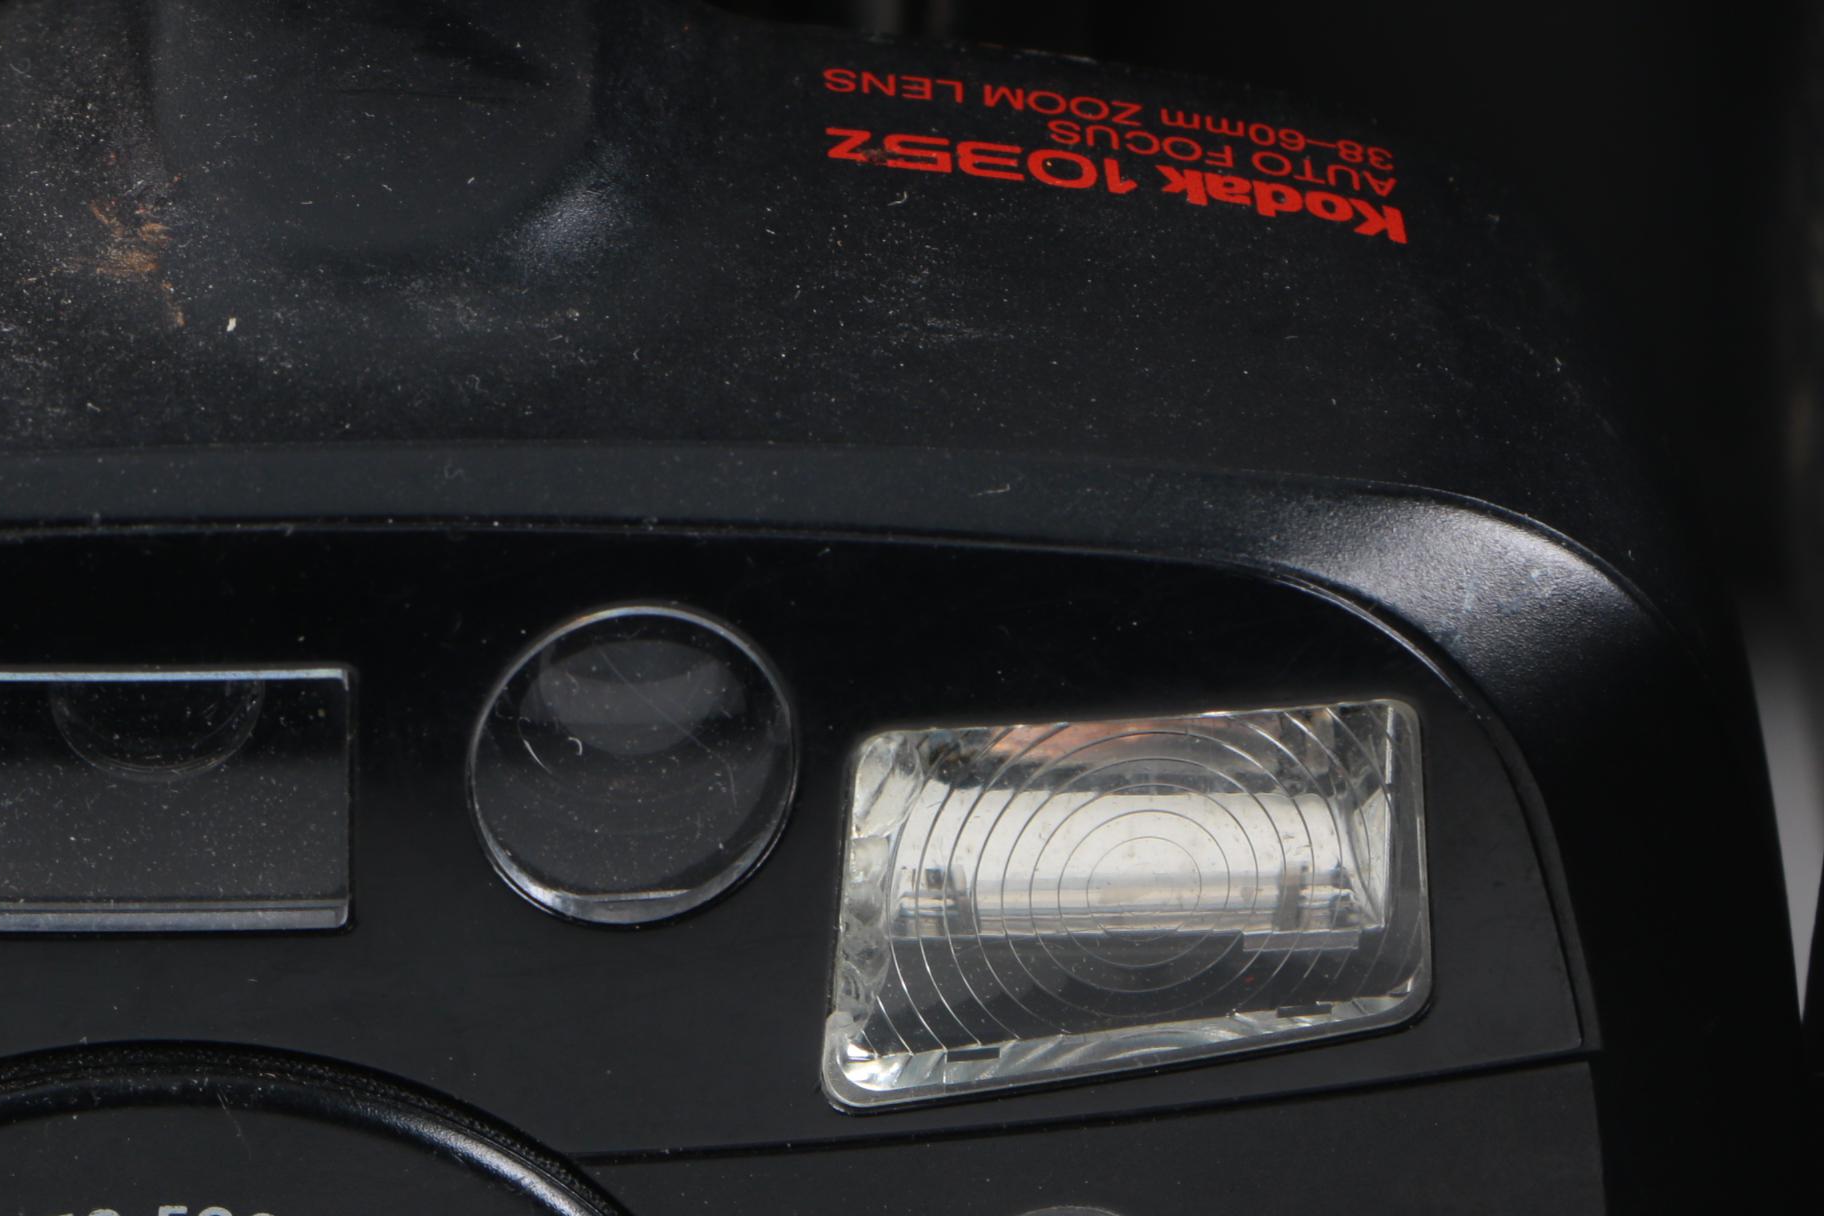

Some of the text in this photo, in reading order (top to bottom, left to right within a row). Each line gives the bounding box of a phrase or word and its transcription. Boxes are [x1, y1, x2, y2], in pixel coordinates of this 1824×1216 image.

[823, 68, 965, 103] LENS
[983, 84, 1142, 127] ZOOM
[1047, 119, 1397, 197] AUTO FOCUS
[1156, 164, 1409, 244] Kodak
